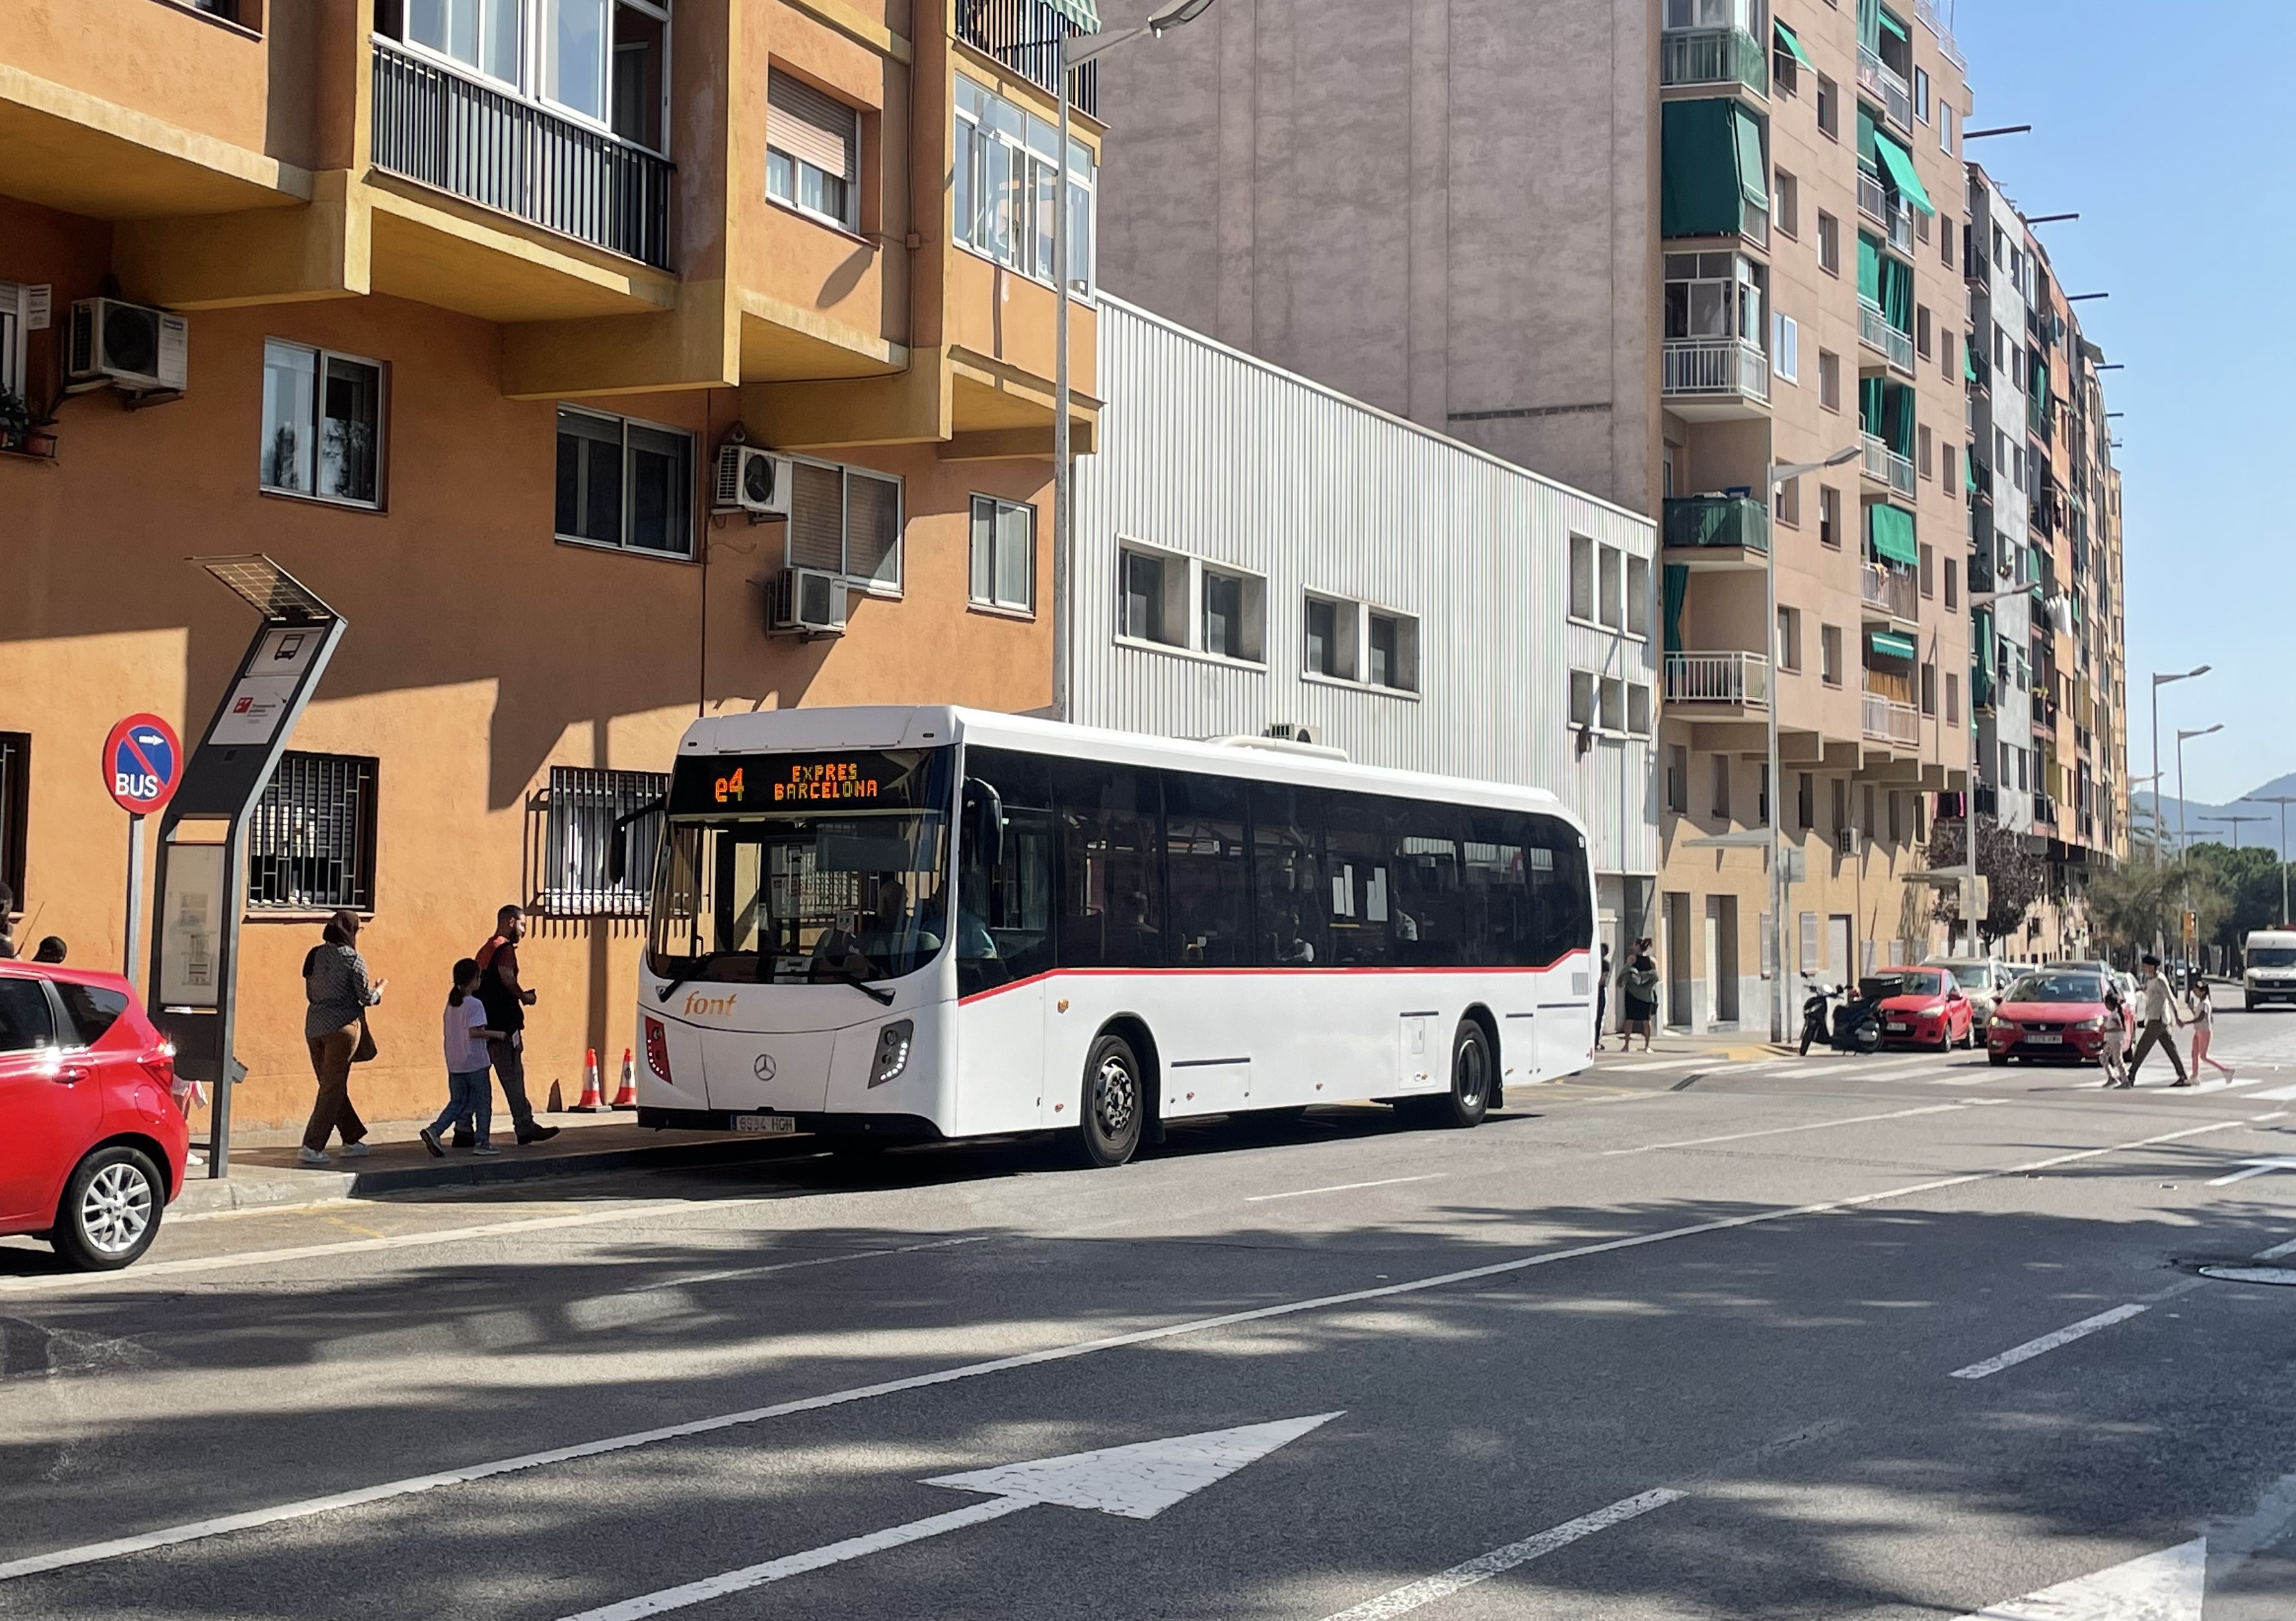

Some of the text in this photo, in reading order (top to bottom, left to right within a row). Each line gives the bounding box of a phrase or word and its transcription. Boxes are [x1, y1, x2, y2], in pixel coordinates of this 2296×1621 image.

[115, 773, 158, 797] BUS
[715, 767, 745, 802] e4
[792, 763, 858, 783] EXPRES
[774, 780, 878, 802] BARCELONA
[684, 990, 737, 1016] font
